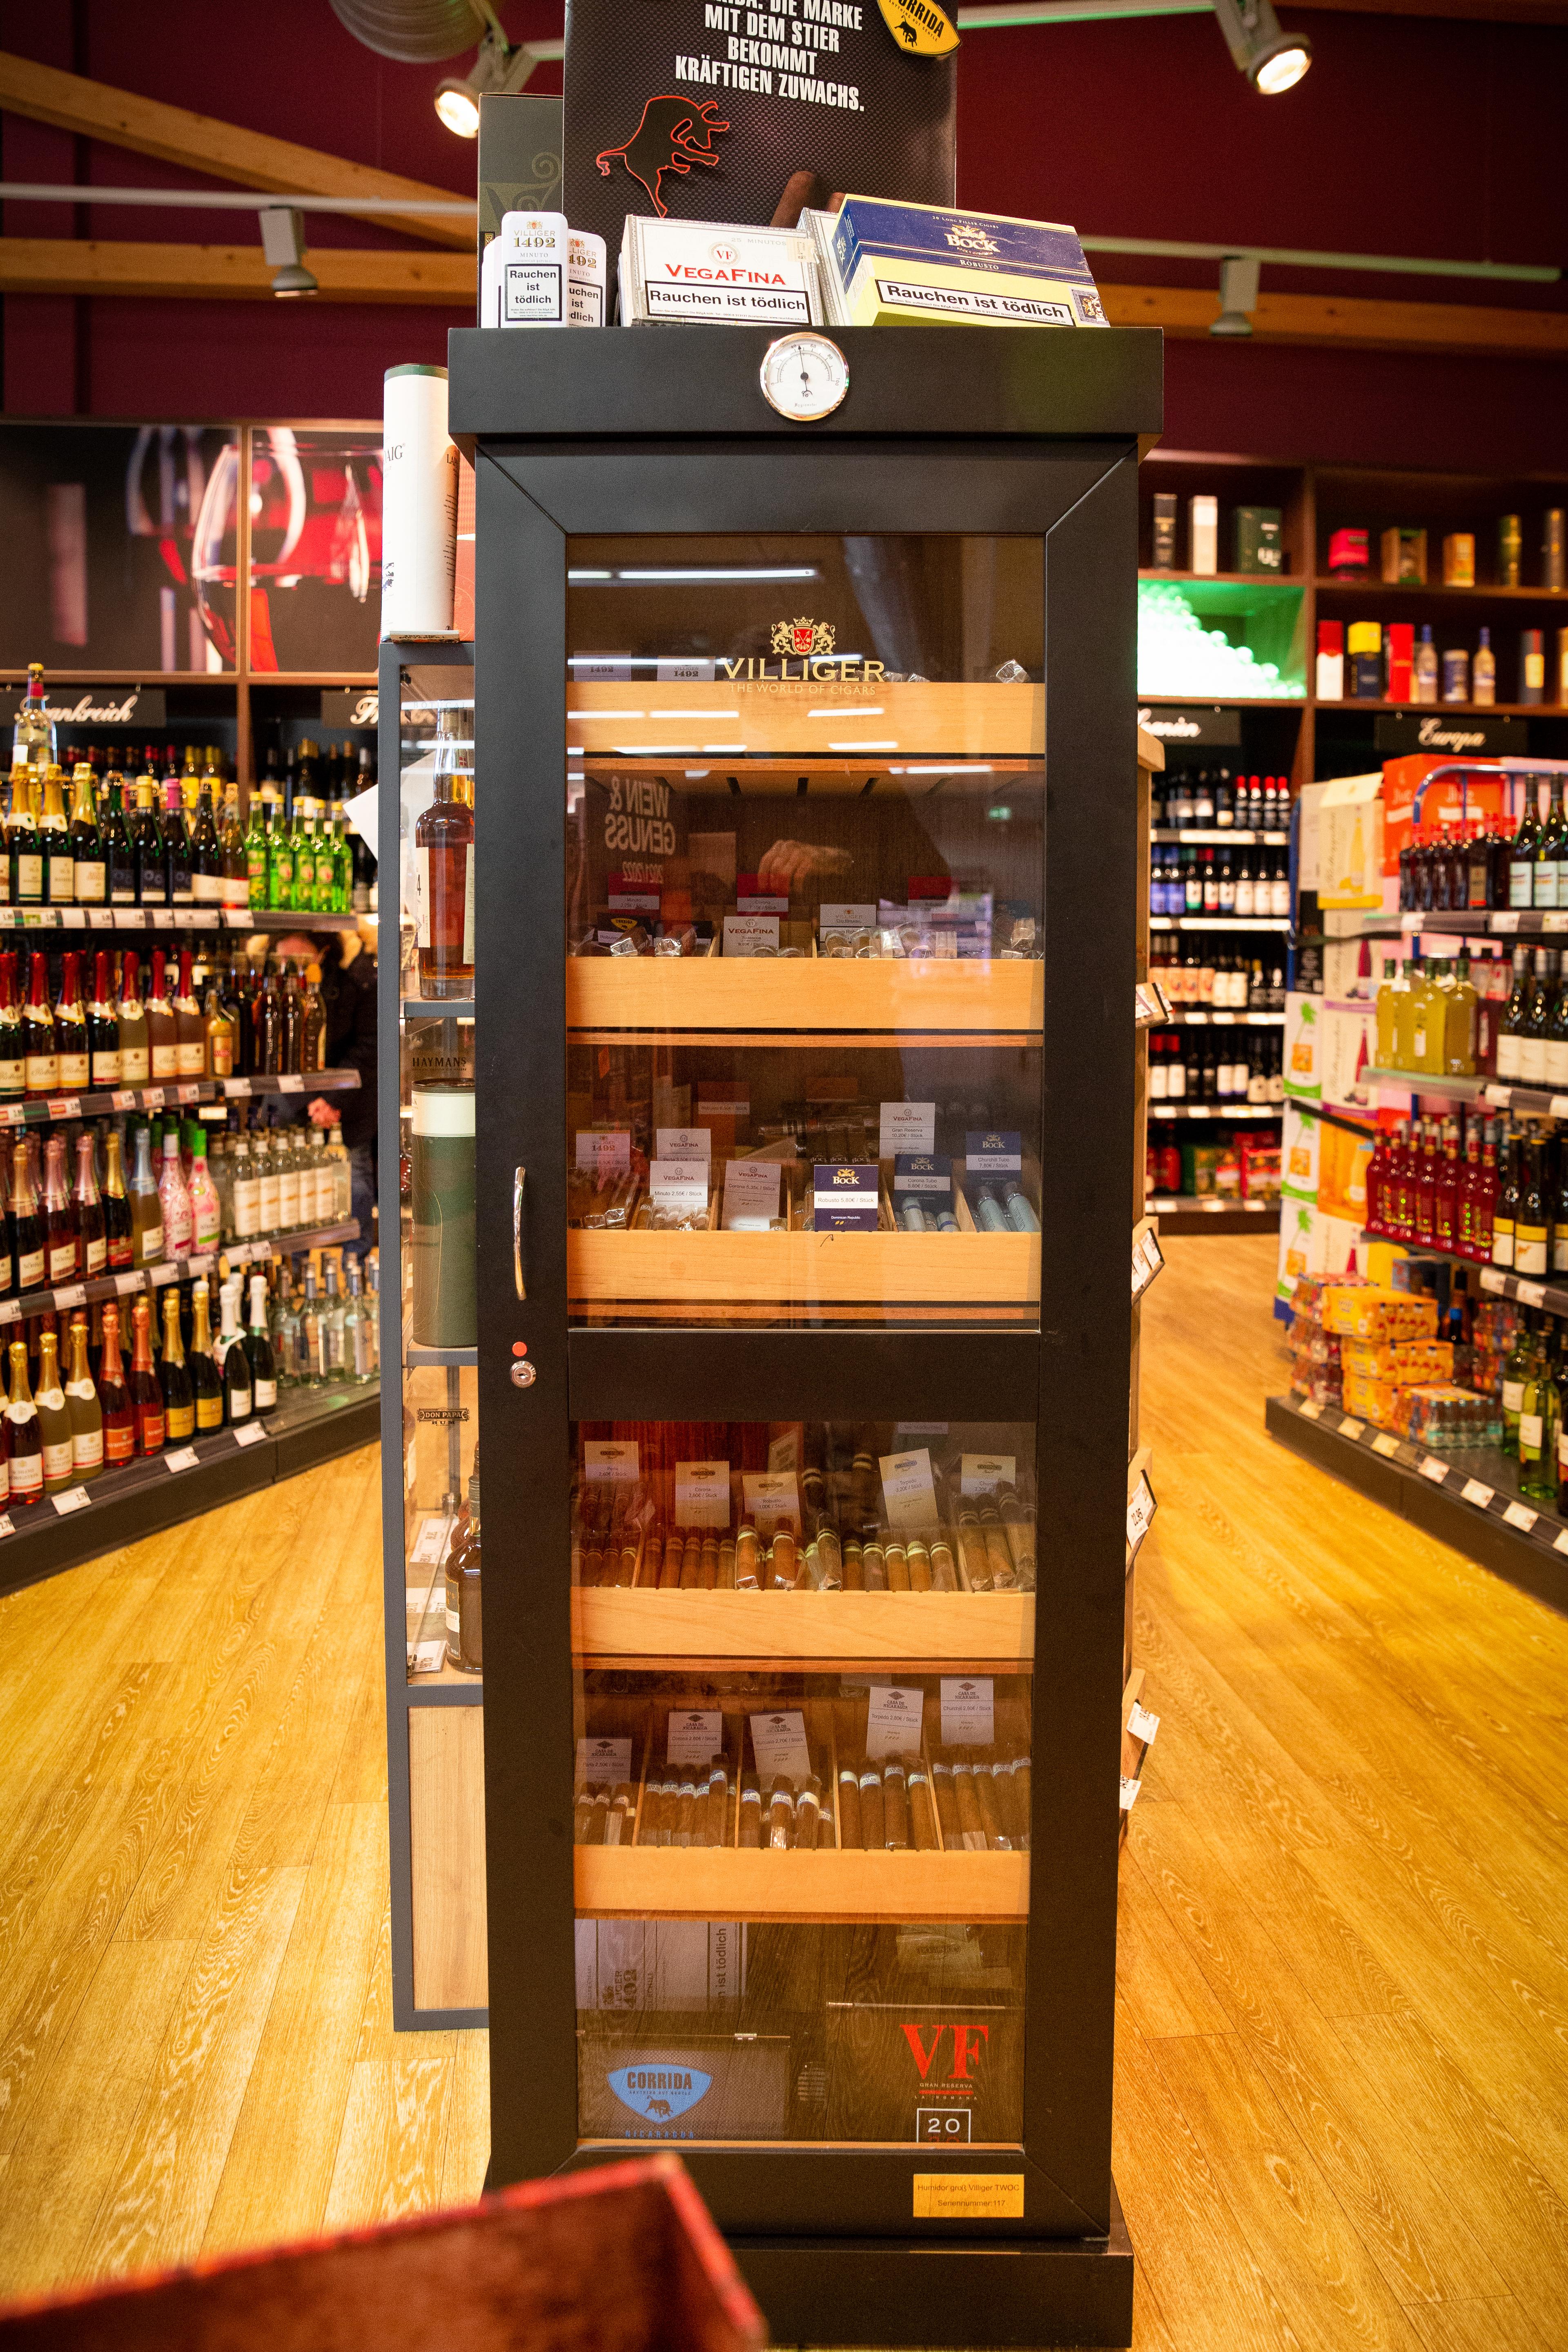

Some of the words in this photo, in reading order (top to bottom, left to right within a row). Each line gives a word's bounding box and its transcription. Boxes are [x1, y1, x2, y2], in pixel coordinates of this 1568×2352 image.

[804, 0, 862, 30] MARKE
[705, 4, 740, 29] MIT
[747, 12, 785, 42] DEM
[792, 21, 839, 52] STIER
[728, 37, 817, 75] BEKOMMT
[675, 55, 772, 94] KRÄFTIGEN
[779, 73, 865, 111] ZUWACHS.
[513, 237, 555, 248] 1492
[944, 233, 1001, 253] BOCK
[716, 250, 733, 260] VF
[960, 260, 1000, 270] ROBUSTO
[510, 270, 557, 278] Rauchen
[515, 296, 552, 304] tödlich
[572, 299, 584, 309] ist
[650, 290, 722, 305] Rauchen
[727, 295, 747, 307] ist
[752, 297, 806, 310] tödlich
[887, 285, 969, 306] Rauchen
[974, 296, 998, 310] ist
[1002, 300, 1065, 318] tödlich
[720, 657, 885, 682] VILLIGER
[729, 684, 753, 693] THE
[755, 684, 803, 694] WORLD
[808, 684, 824, 694] OF
[831, 685, 876, 696] CIGARS
[412, 1057, 466, 1067] HAYMANS
[833, 1176, 860, 1184] BOCK
[715, 1928, 727, 1971] tödlich
[716, 1972, 726, 1988] ist
[900, 2024, 989, 2080] VF
[627, 2072, 693, 2090] CORRIDA
[625, 2130, 694, 2138] NICARAGUA
[927, 2118, 960, 2134] 20
